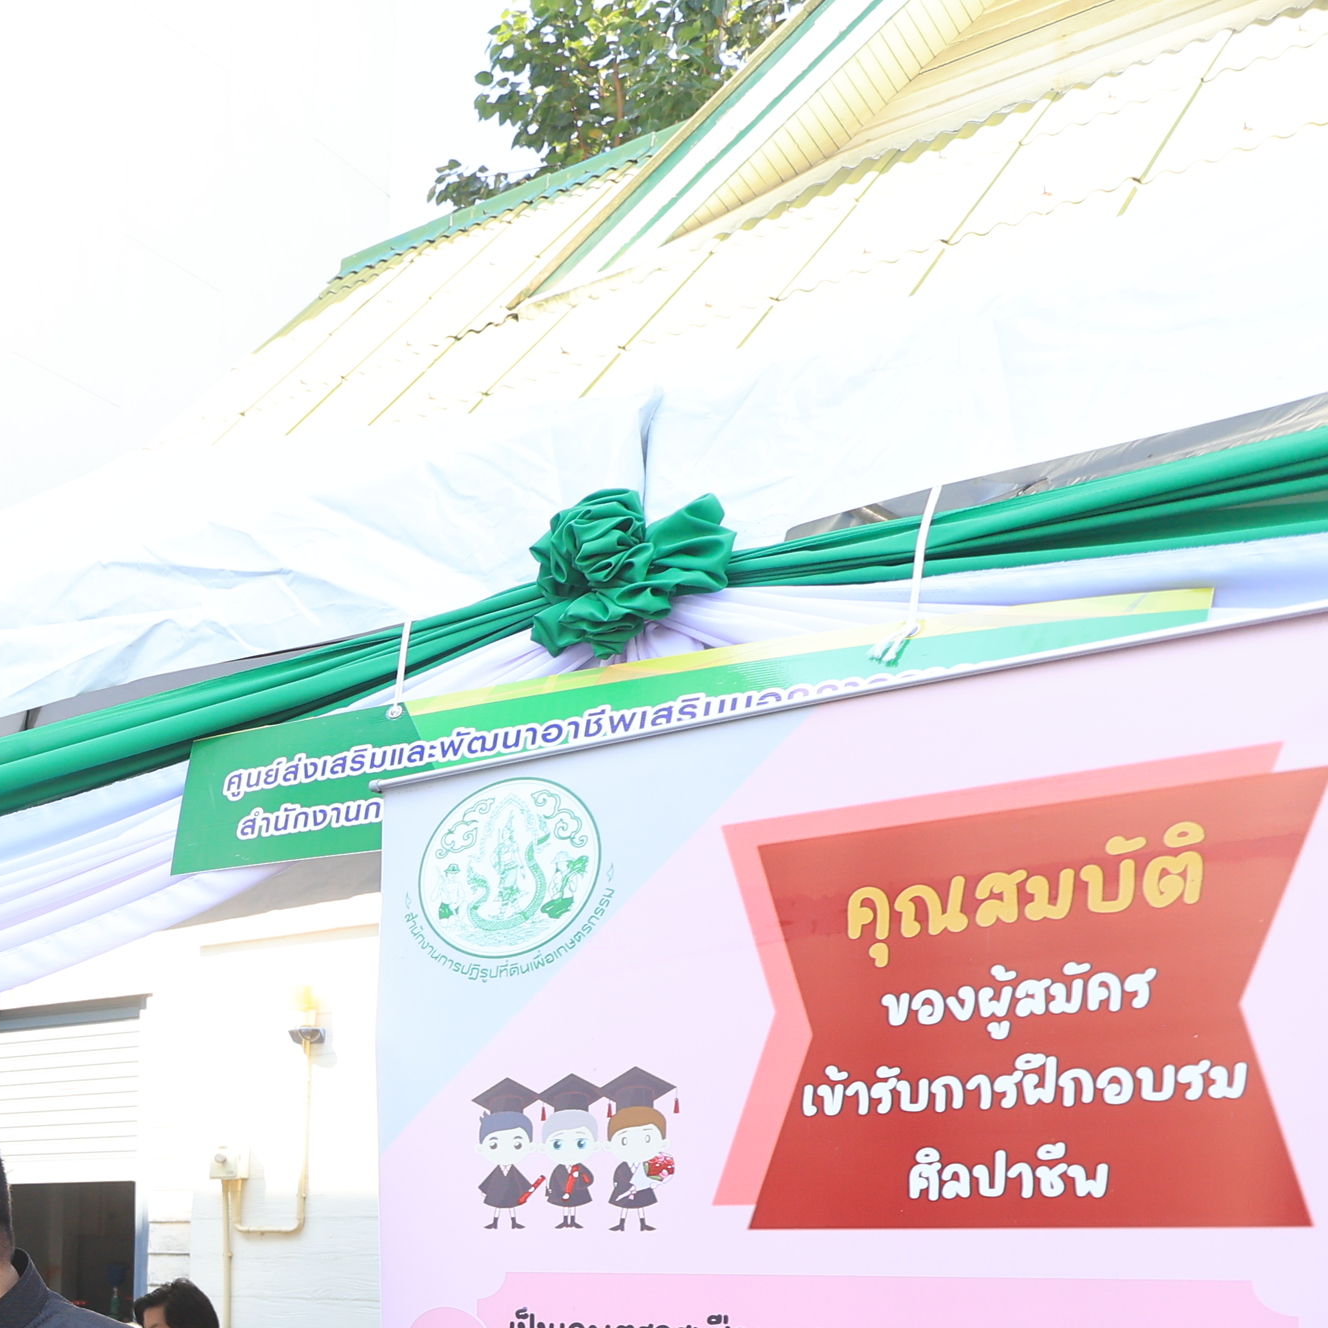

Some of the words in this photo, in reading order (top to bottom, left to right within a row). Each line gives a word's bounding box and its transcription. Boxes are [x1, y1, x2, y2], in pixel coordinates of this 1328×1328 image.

[240, 801, 381, 838] สำนักงานก
[847, 820, 1207, 968] คุณสมบัติ
[881, 961, 1157, 1040] ของผู้สมัคร
[802, 1053, 1248, 1117] เข้ารับการฝึกอบรม
[909, 1142, 1109, 1201] ศิลปาชีพ
